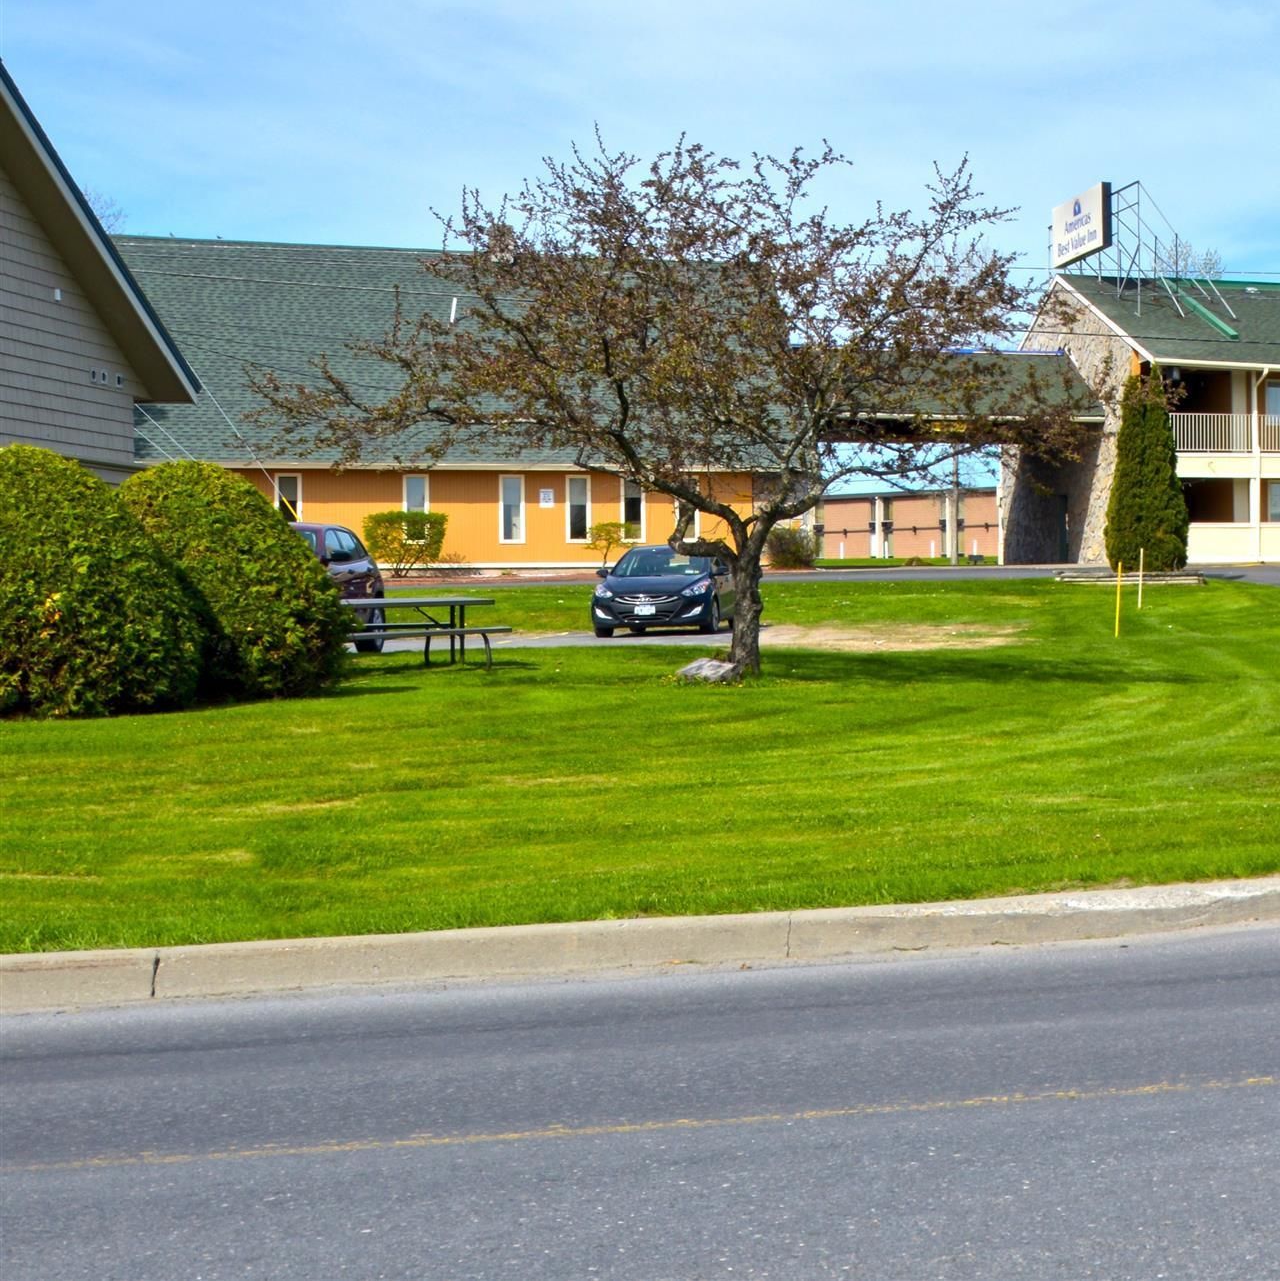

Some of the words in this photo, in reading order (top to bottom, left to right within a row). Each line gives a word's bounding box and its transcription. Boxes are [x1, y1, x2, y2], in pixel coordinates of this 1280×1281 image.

[1065, 212, 1091, 236] Americas
[1058, 239, 1069, 257] Best
[1071, 232, 1086, 251] Value
[1087, 229, 1097, 243] Inn
